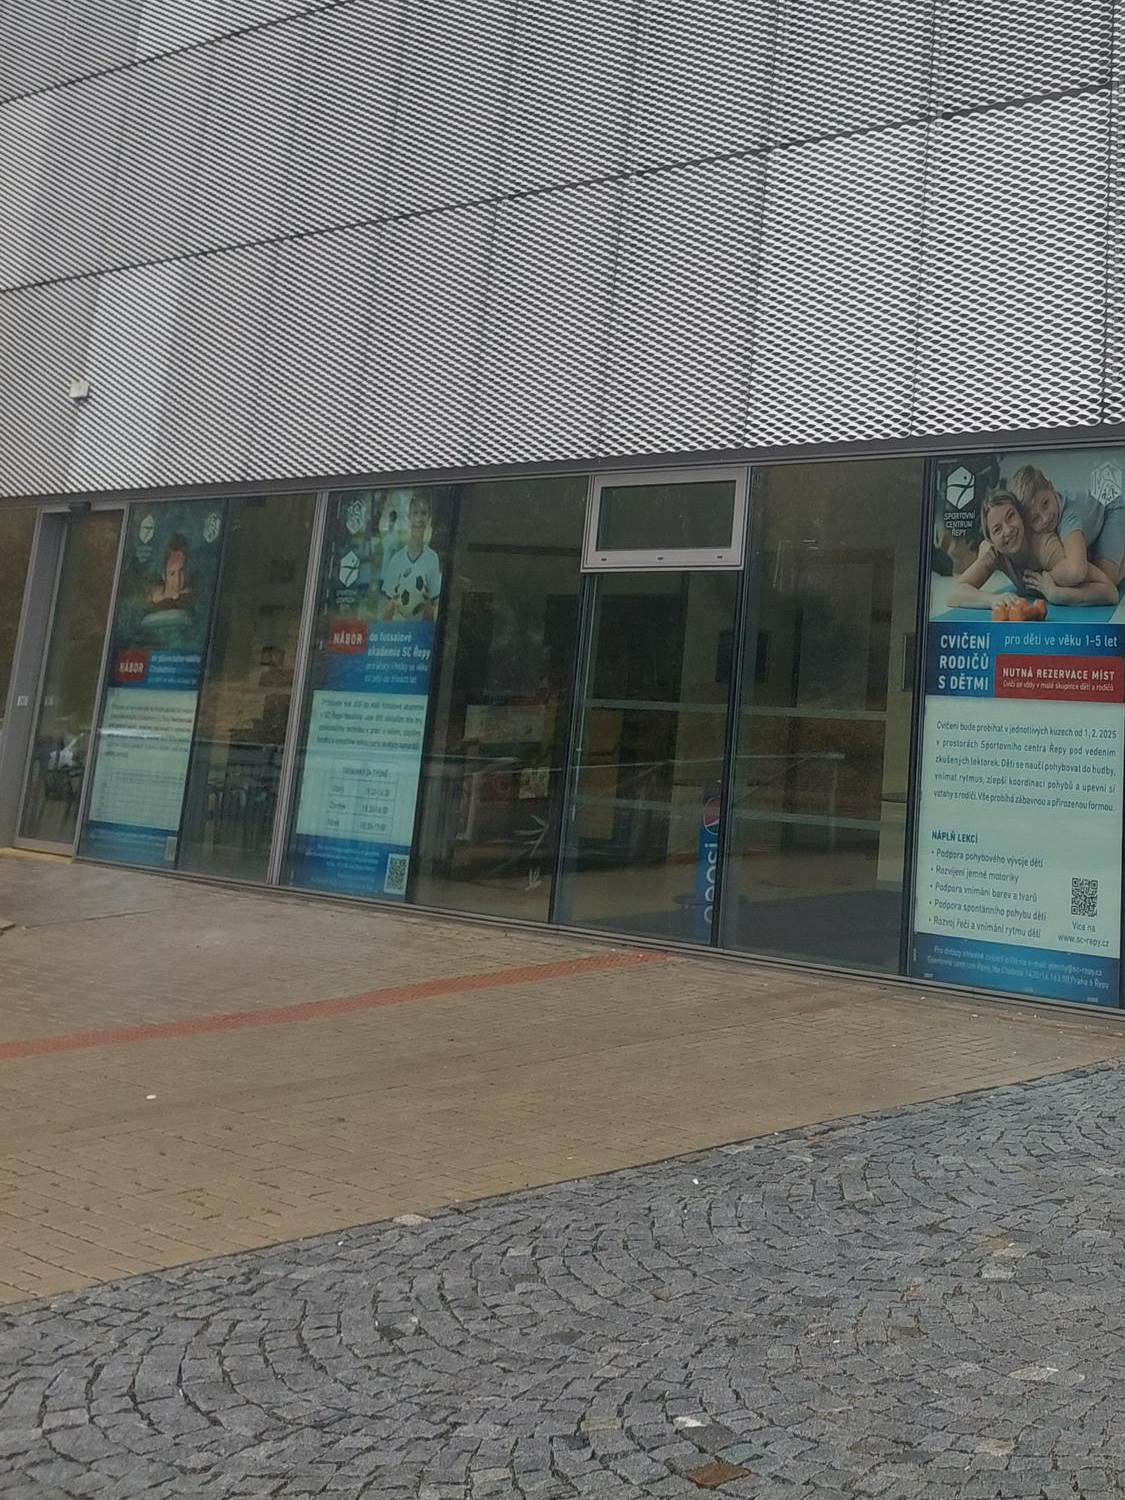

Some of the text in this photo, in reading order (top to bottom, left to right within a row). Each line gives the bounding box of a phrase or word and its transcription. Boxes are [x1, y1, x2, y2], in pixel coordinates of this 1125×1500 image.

[945, 520, 973, 528] CENTRUM
[333, 630, 363, 645] NÁBOR
[940, 632, 991, 650] CVIČENÍ
[1004, 635, 1021, 648] pro
[1023, 632, 1041, 645] děti
[1044, 636, 1055, 645] ve
[1059, 634, 1081, 646] věku
[1104, 635, 1118, 648] let
[401, 646, 412, 657] SC
[939, 652, 989, 670] RODIČŮ
[938, 673, 989, 691] S DĚTMI
[1003, 667, 1115, 680] NUTNÁ REZERVACE MÍST
[1055, 682, 1079, 691] skupince
[937, 720, 959, 731] Cvičení
[960, 722, 976, 732] bude
[976, 723, 1004, 734] probíhat
[1009, 724, 1048, 736] jednotlivých
[1050, 726, 1073, 737] kuzech
[1074, 728, 1082, 737] od
[1099, 729, 1117, 739] 2025
[942, 739, 978, 749] prostorách
[981, 740, 1022, 751] Sportovního
[1024, 743, 1046, 752] centra
[1049, 744, 1066, 755] Řepy
[1069, 746, 1082, 756] pod
[1085, 747, 1116, 757] vedením
[935, 756, 969, 767] zkušených
[970, 758, 1000, 767] lektorek.
[1001, 758, 1015, 768] Děti
[1025, 760, 1044, 769] naučí
[1044, 762, 1081, 774] pohybovat
[1082, 764, 1091, 773] do
[1092, 765, 1116, 777] hudby,
[935, 773, 957, 781] vnímat
[959, 775, 985, 785] rytmus,
[986, 776, 1007, 786] zlepší
[1047, 780, 1074, 792] pohybů
[1082, 783, 1107, 794] upevní
[1109, 784, 1116, 794] si
[933, 790, 954, 800] vztahy
[978, 792, 989, 801] Vše
[990, 794, 1015, 804] probíhá
[1015, 795, 1046, 806] zábavnou
[1051, 798, 1088, 809] přirozenou
[1088, 800, 1116, 812] formou.
[932, 831, 978, 844] NÁPLŇ LEKCÍ
[936, 849, 964, 860] Podpora
[965, 850, 1006, 864] pohybového
[1006, 853, 1029, 867] vývoje
[935, 865, 965, 878] Rozvíjení
[988, 871, 1019, 885] motoriky
[935, 882, 962, 894] Podpora
[963, 885, 991, 896] vnímání
[992, 887, 1012, 899] barev
[1018, 891, 1038, 902] tvarů
[934, 899, 962, 911] Podpora
[963, 903, 1005, 916] spontánního
[1006, 907, 1032, 920] pohybu
[933, 915, 956, 928] Rozvoj
[976, 920, 1005, 933] vnímání
[1005, 926, 1027, 938] rytmu
[1086, 924, 1096, 932] na
[1058, 933, 1110, 948] www.sc-repy.cz
